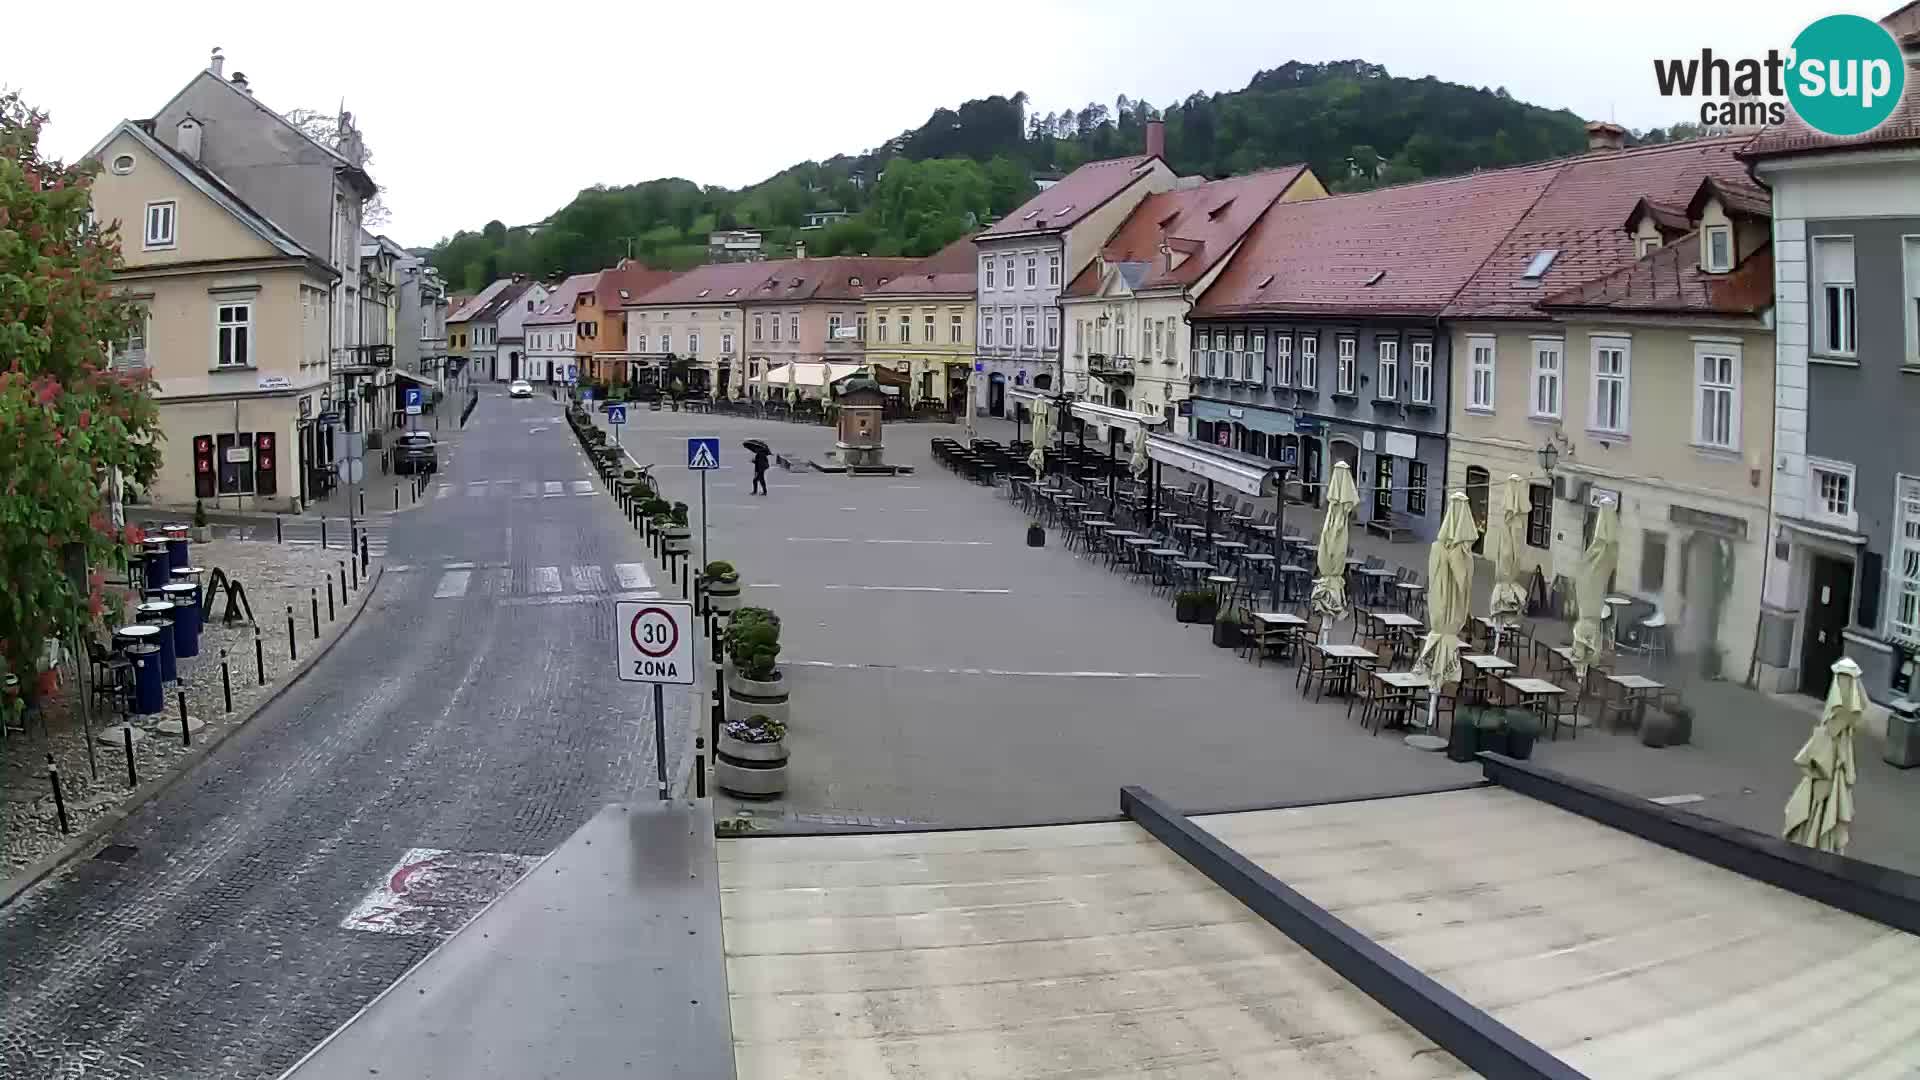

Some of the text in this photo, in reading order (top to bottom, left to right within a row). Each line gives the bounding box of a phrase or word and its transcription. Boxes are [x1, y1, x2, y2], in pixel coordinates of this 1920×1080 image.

[410, 392, 418, 403] P
[643, 623, 667, 644] 30
[633, 660, 678, 677] ZONA
